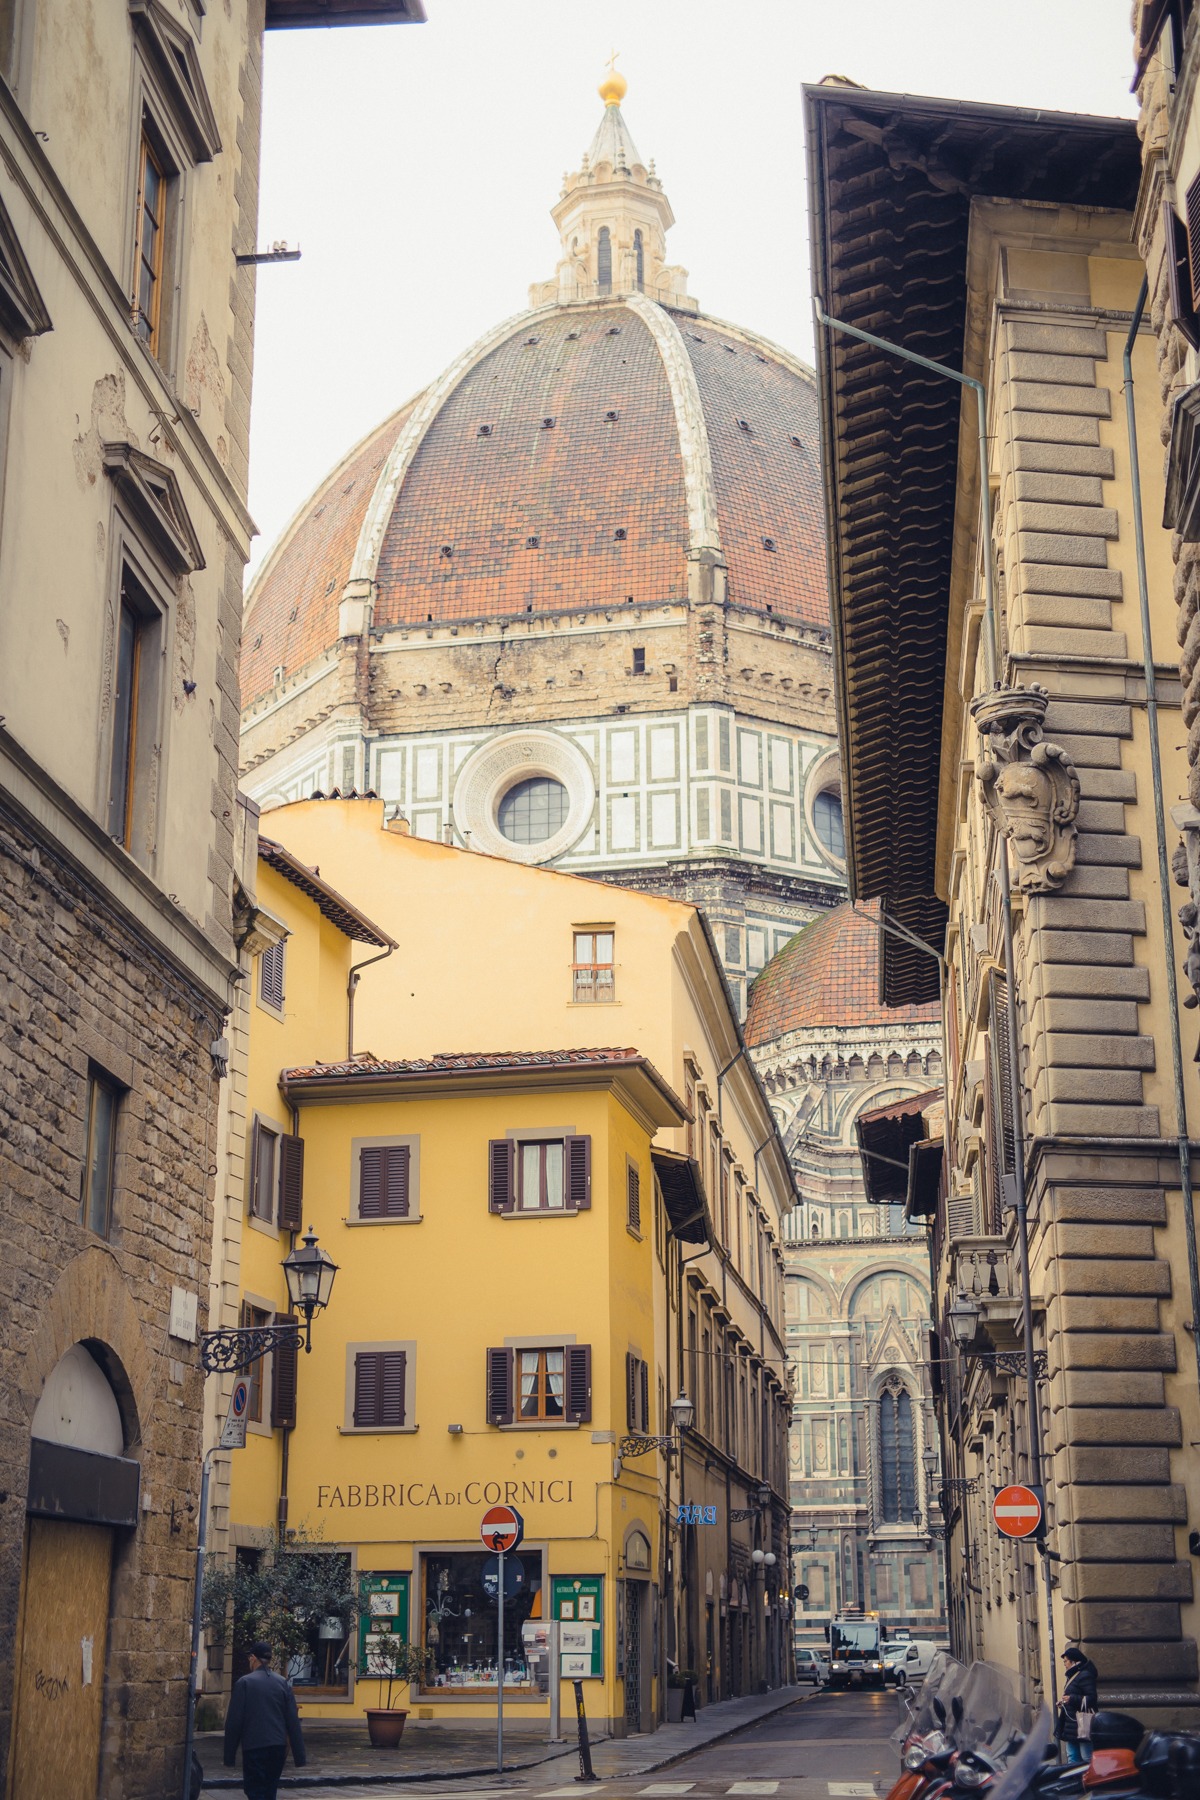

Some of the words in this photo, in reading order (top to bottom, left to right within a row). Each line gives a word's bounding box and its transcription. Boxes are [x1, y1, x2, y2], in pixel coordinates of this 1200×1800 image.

[317, 1483, 442, 1508] FABBRICA
[445, 1492, 462, 1506] DI
[465, 1480, 573, 1505] CORNICI
